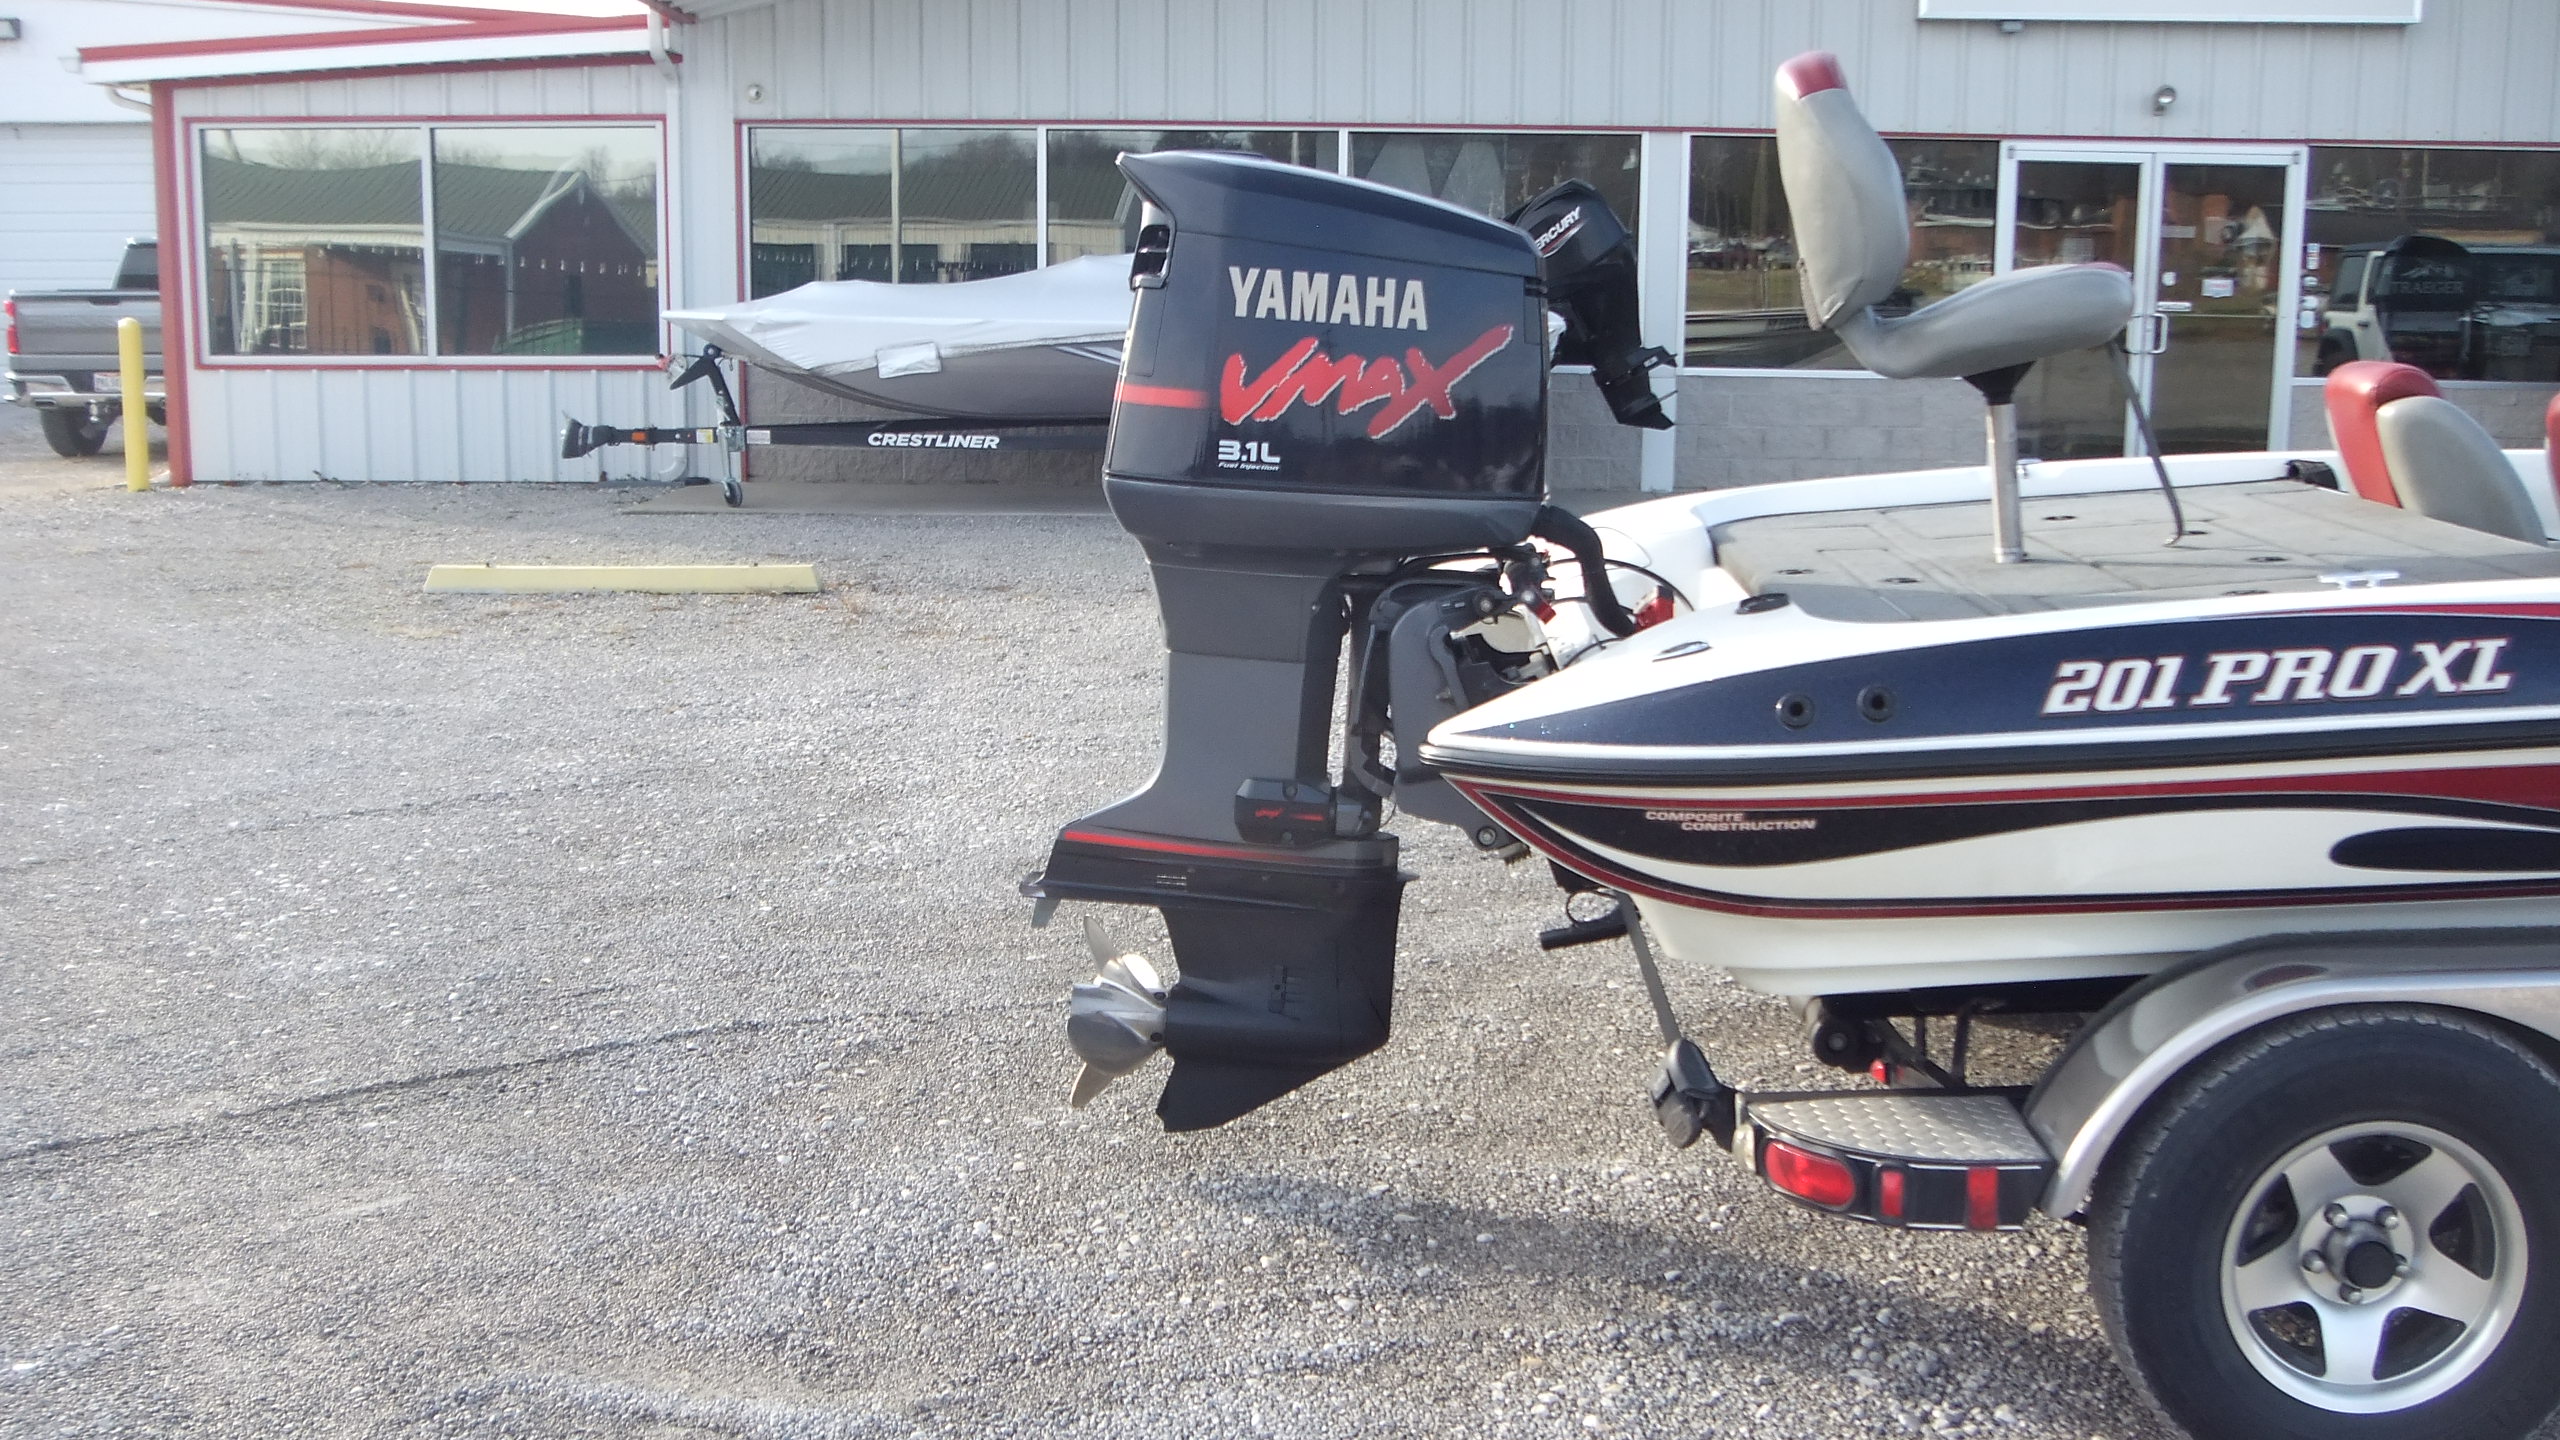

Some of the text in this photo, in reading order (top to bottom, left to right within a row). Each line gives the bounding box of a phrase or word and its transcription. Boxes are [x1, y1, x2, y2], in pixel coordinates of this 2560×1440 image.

[1534, 205, 1581, 250] ERCURY
[1228, 266, 1428, 331] YAMAHA
[867, 432, 1001, 450] CRESTLINER
[1218, 439, 1281, 464] 3.1L
[2041, 637, 2513, 716] 201 PRO XL
[1644, 810, 1745, 822] COMPOSITE
[1680, 819, 1818, 832] CONSTRUCTION
